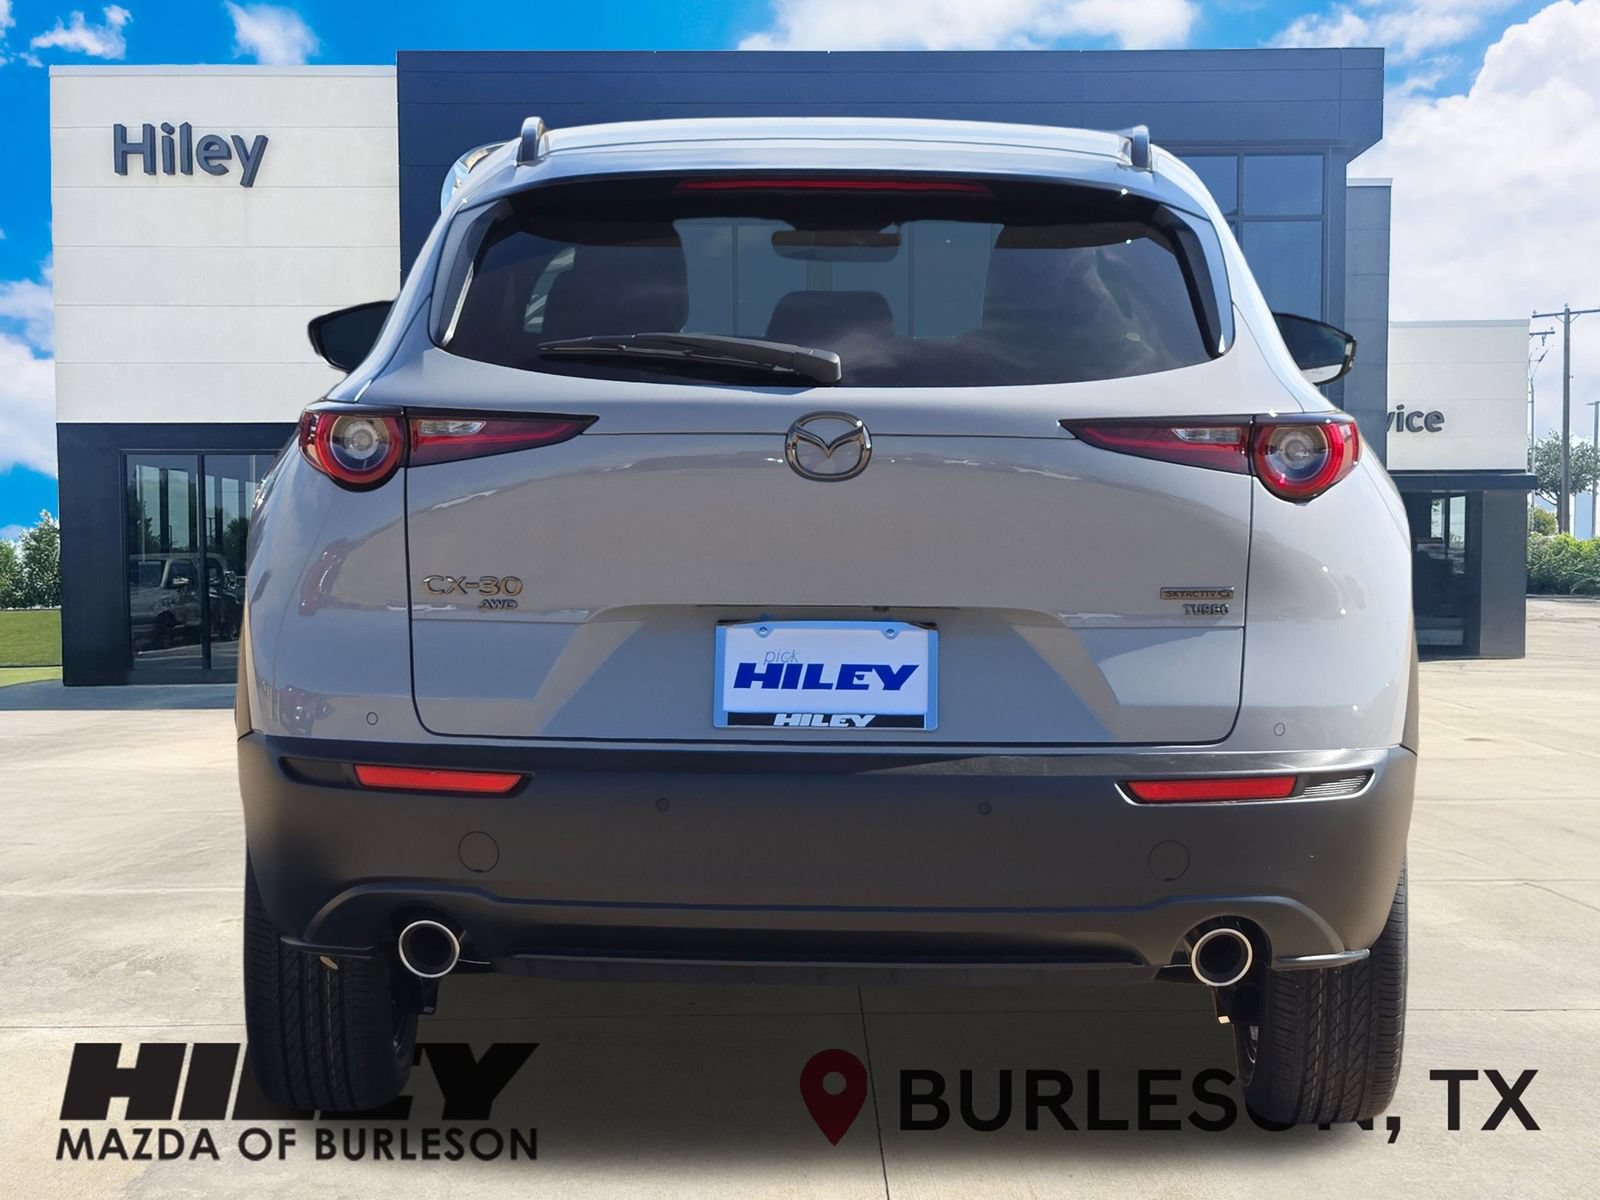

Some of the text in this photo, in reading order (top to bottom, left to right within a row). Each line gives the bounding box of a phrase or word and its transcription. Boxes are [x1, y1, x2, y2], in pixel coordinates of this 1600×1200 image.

[113, 122, 269, 188] Hiley
[423, 575, 523, 597] CX-30
[479, 599, 519, 609] AWD
[1182, 603, 1229, 616] TURBO
[763, 649, 799, 666] pick
[733, 662, 920, 691] HILEY
[773, 713, 876, 728] HILEY
